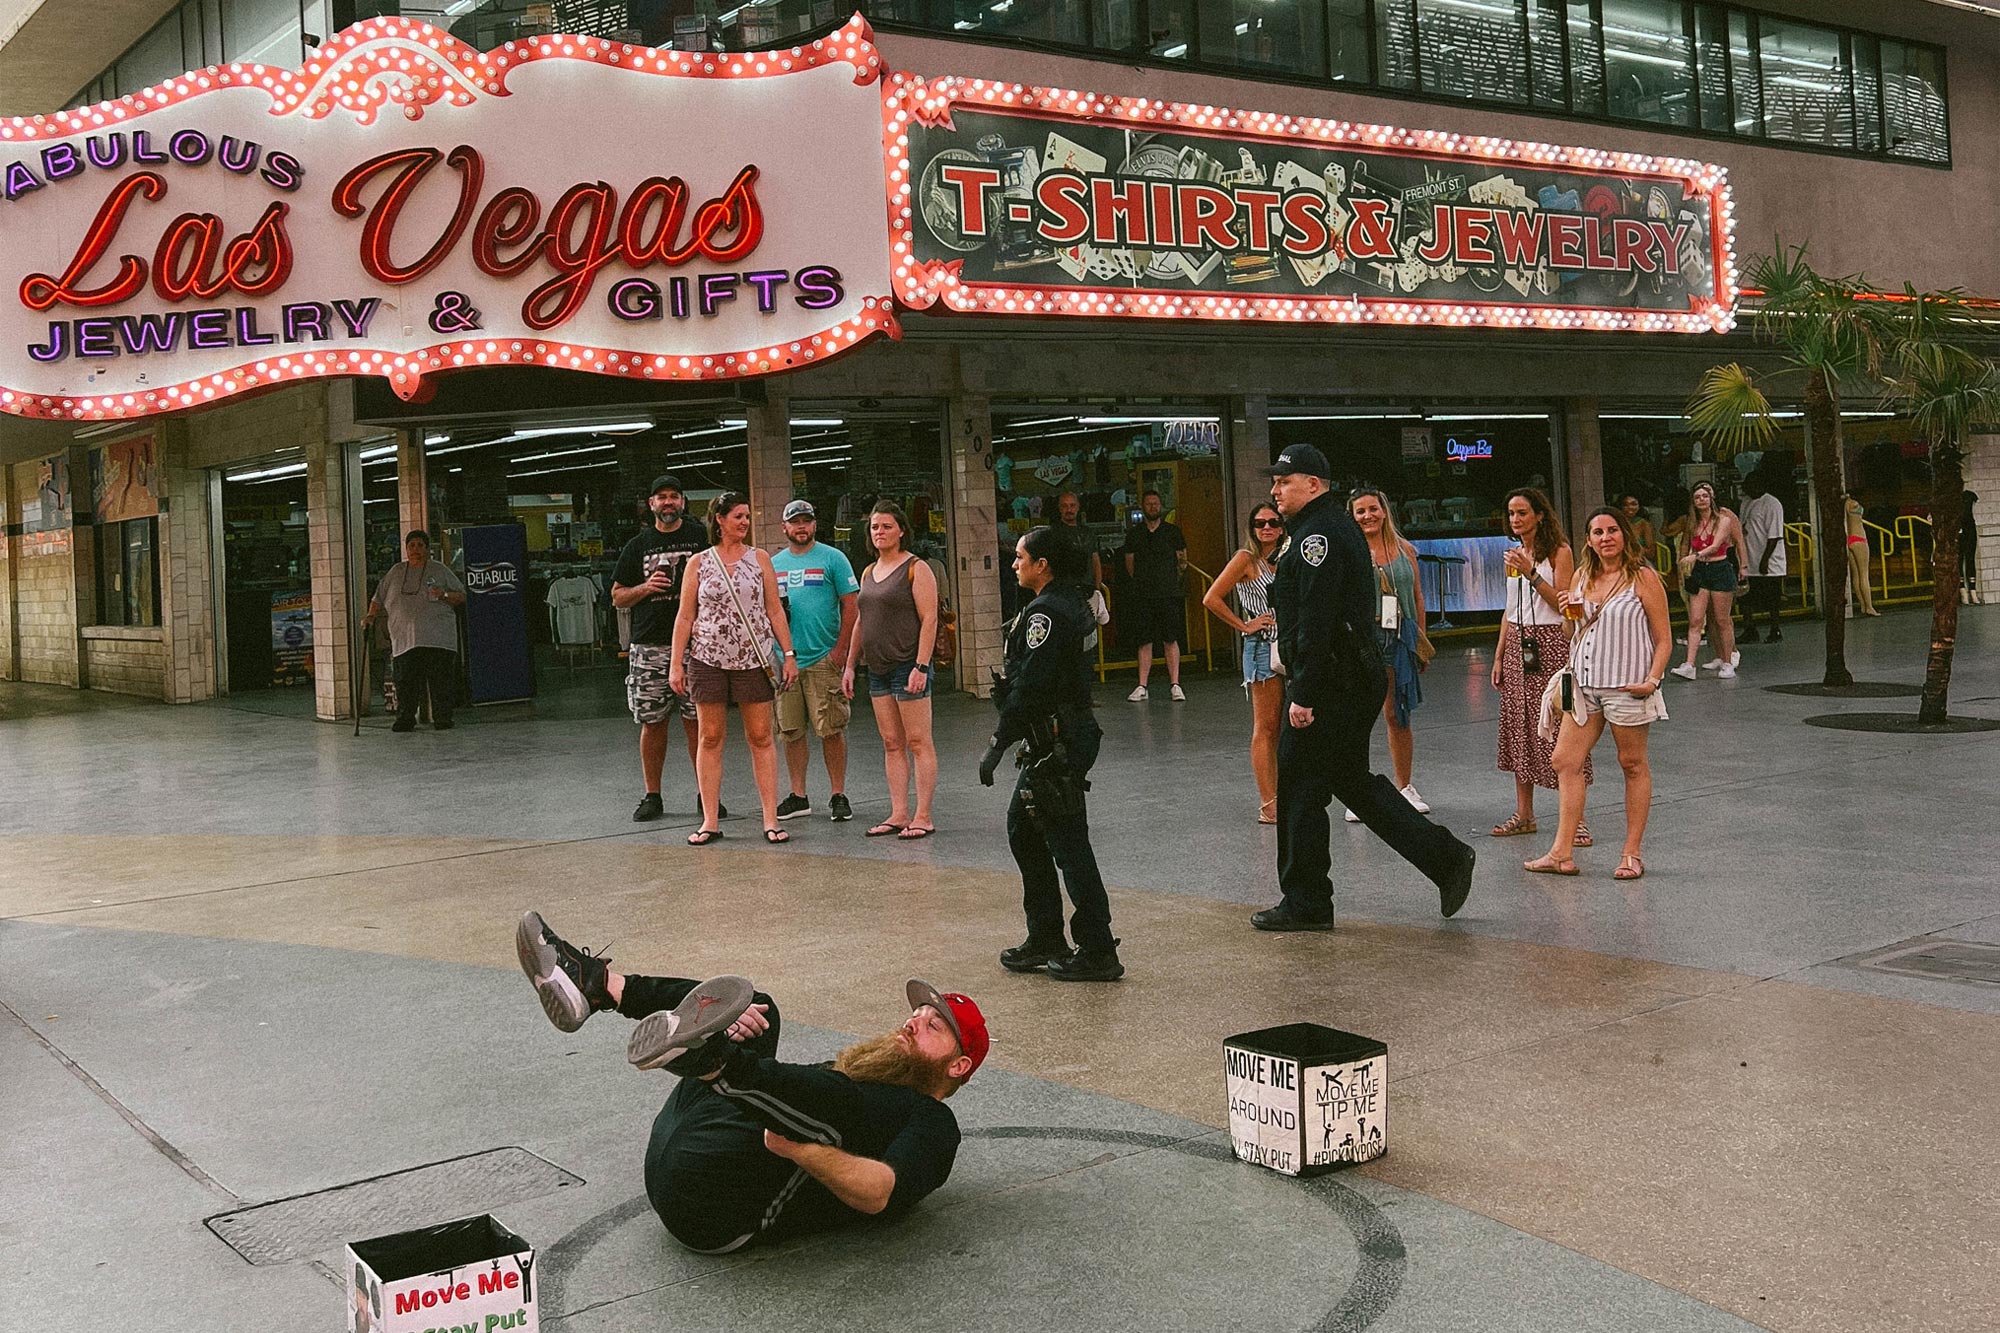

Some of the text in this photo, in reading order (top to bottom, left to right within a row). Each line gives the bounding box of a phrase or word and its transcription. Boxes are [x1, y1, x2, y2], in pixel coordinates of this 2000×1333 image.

[0, 129, 305, 201] ABULOUS
[1130, 153, 1157, 173] ELVIS
[1405, 181, 1447, 201] FREMONT
[941, 164, 1688, 275] T-SHIRTS & JEWELRY
[19, 144, 765, 331] Las Vegas
[27, 265, 844, 363] JEWELRY & GIFTS
[964, 418, 993, 470] 300
[1447, 438, 1477, 462] Oxygen
[1227, 1048, 1296, 1091] MOVE ME
[1316, 1078, 1379, 1102] MOVE ME
[1317, 1094, 1377, 1121] TIP ME
[1230, 1096, 1296, 1131] AROUND
[1243, 1140, 1268, 1165] STAY
[395, 1270, 519, 1315] Move Me
[485, 1308, 528, 1333] Put
